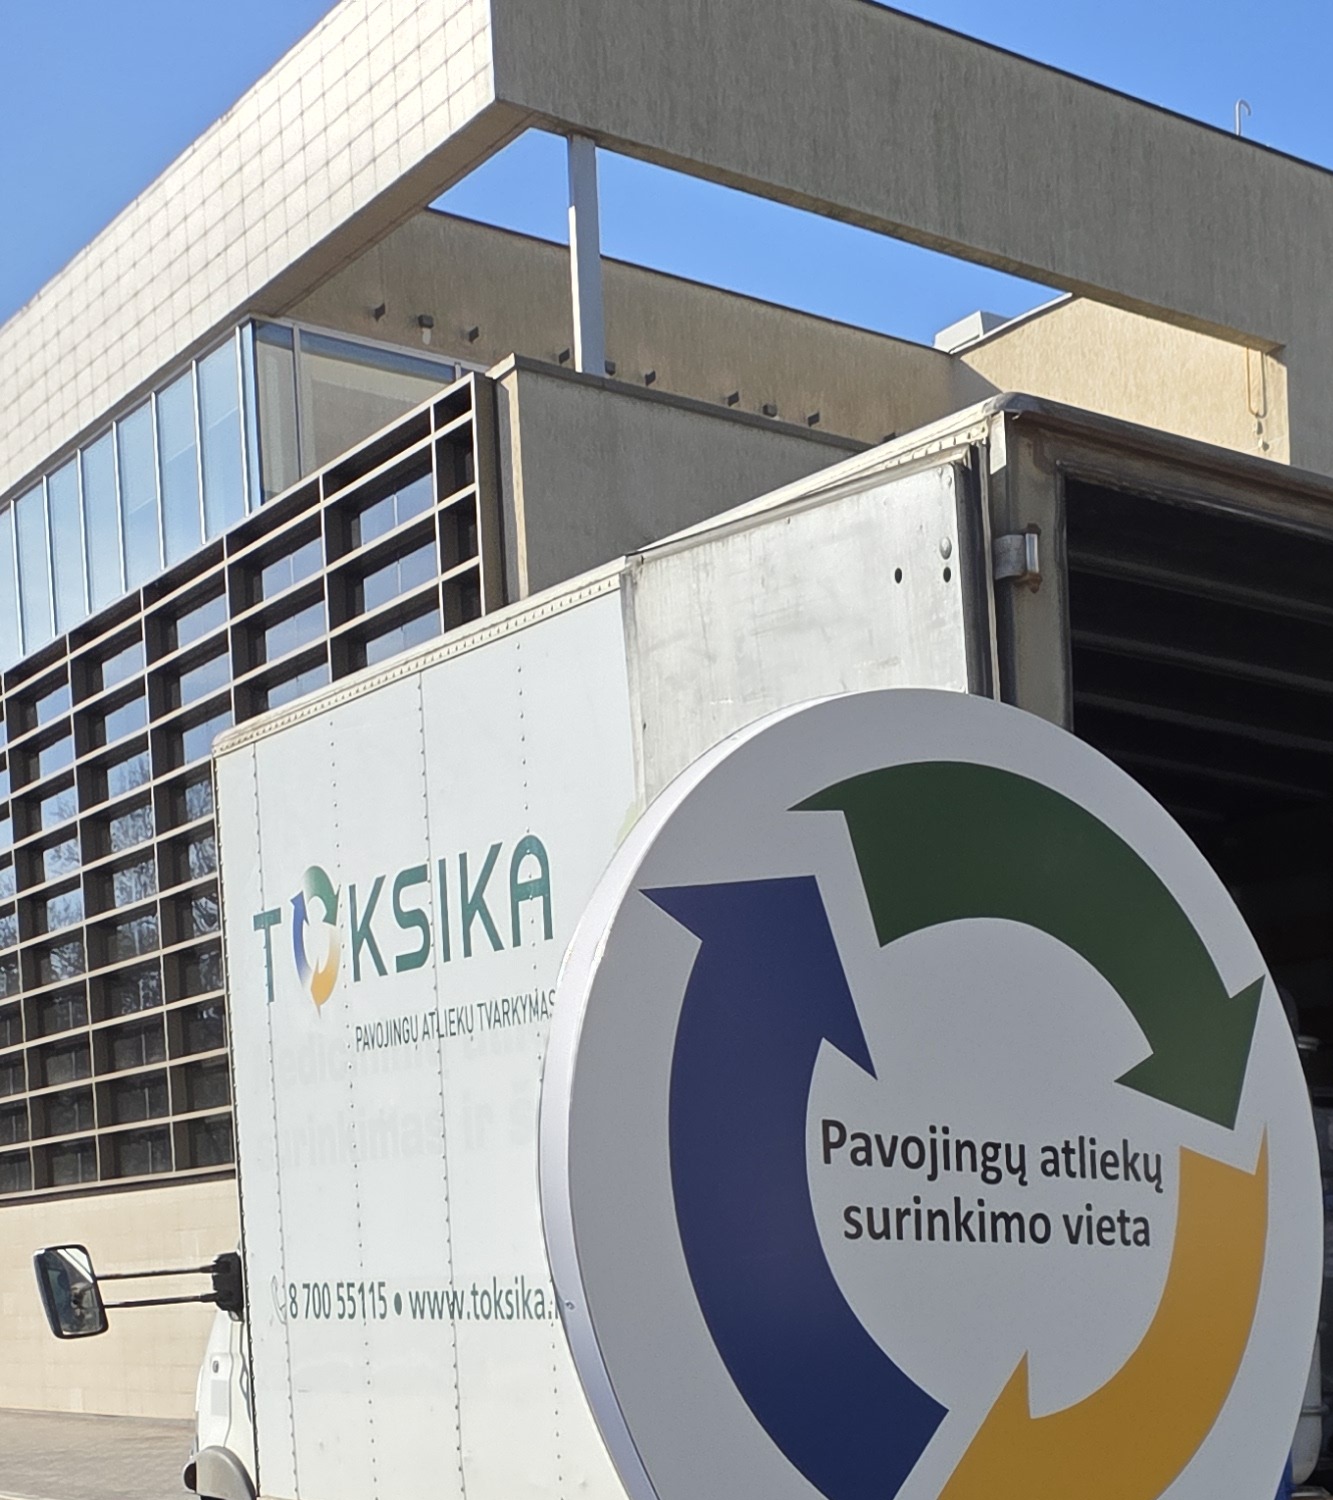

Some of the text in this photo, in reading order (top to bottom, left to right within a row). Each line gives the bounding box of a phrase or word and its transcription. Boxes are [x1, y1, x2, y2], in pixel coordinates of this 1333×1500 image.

[253, 834, 554, 1018] TOKSIKA
[355, 1013, 419, 1052] PAVOJINGŲ
[421, 1003, 475, 1042] ATLIEKŲ
[820, 1118, 1164, 1194] Pavojingų atliekų
[842, 1195, 1151, 1247] surinkimo vieta
[288, 1282, 299, 1319] 8
[302, 1281, 332, 1320] 700
[336, 1281, 388, 1321] 55115
